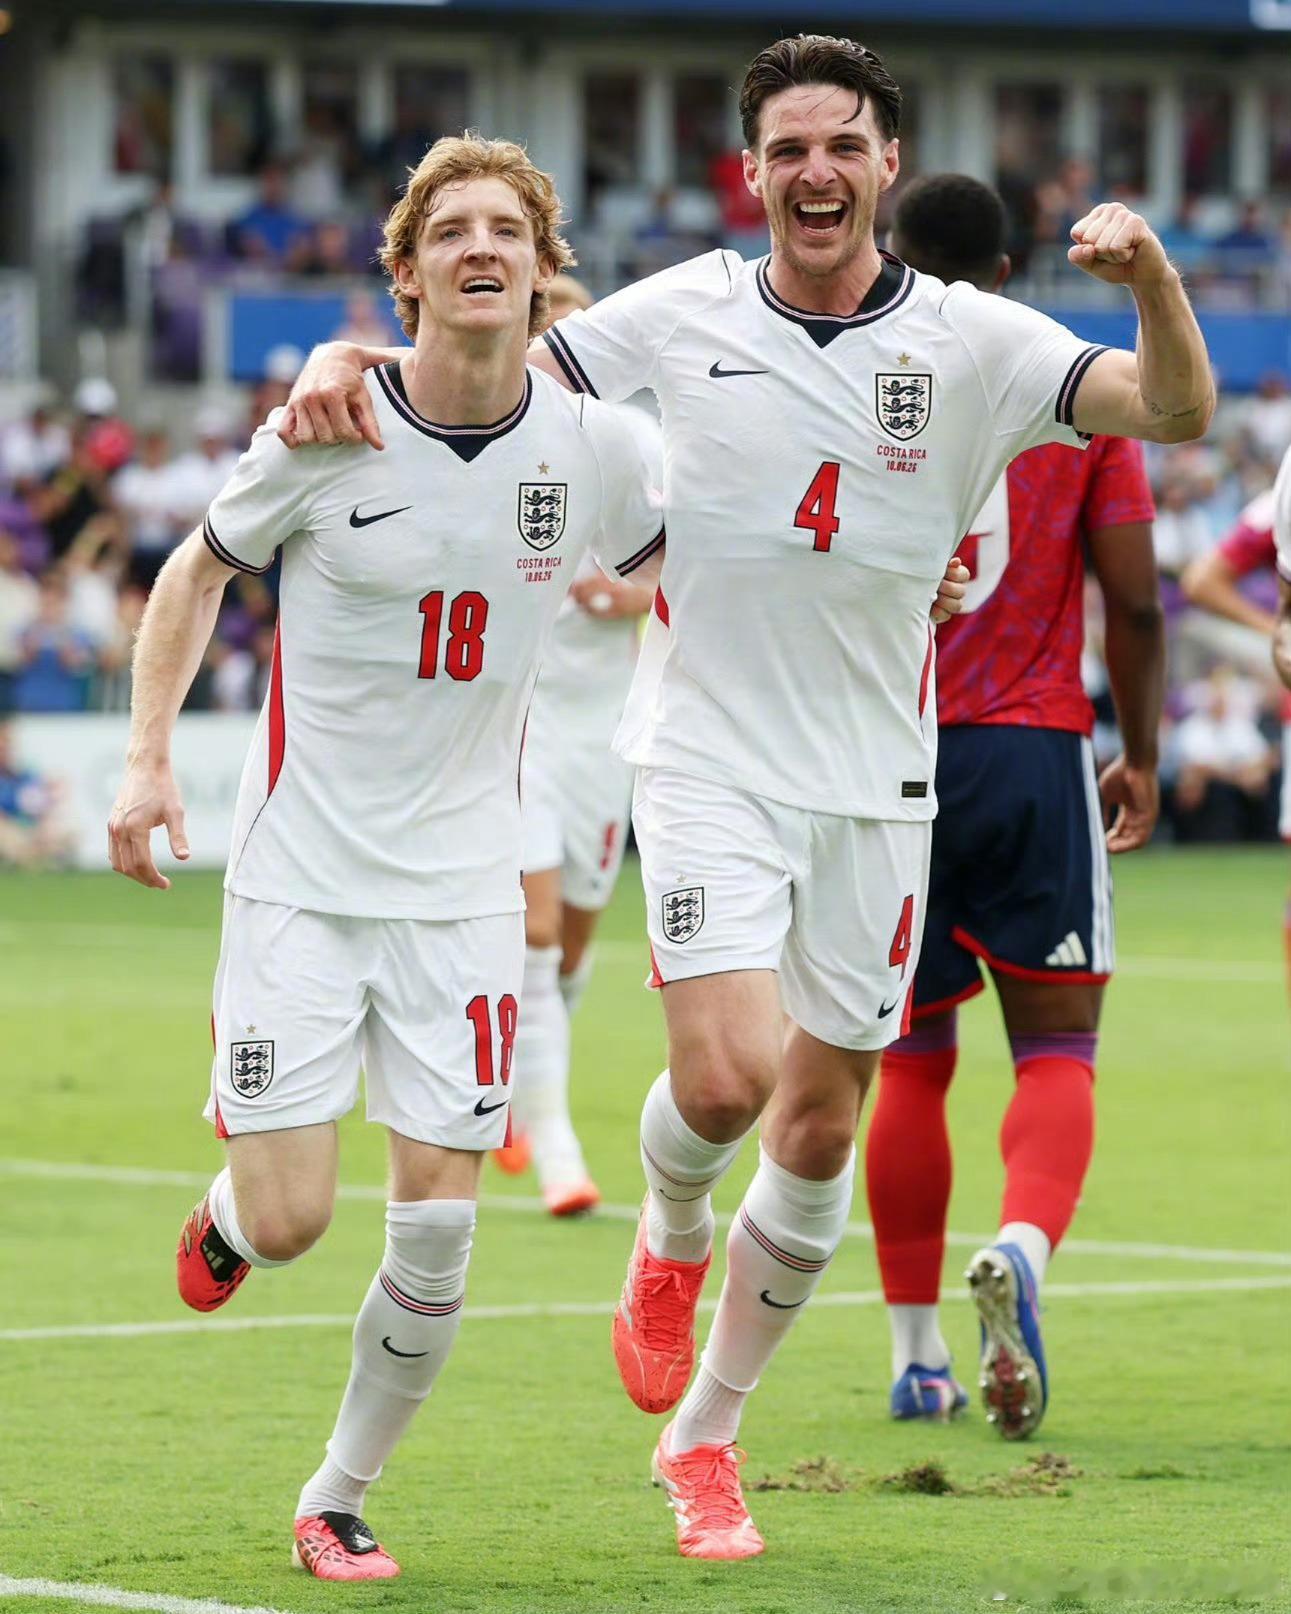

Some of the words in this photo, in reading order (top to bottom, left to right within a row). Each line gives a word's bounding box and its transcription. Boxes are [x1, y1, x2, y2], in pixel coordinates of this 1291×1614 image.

[876, 444, 907, 459] COSTA
[908, 448, 926, 460] RICA
[793, 461, 841, 552] 4
[516, 558, 543, 569] COSTA
[544, 556, 562, 568] RICA
[417, 590, 489, 682] 18
[888, 893, 914, 982] 4
[465, 993, 518, 1086] 18
